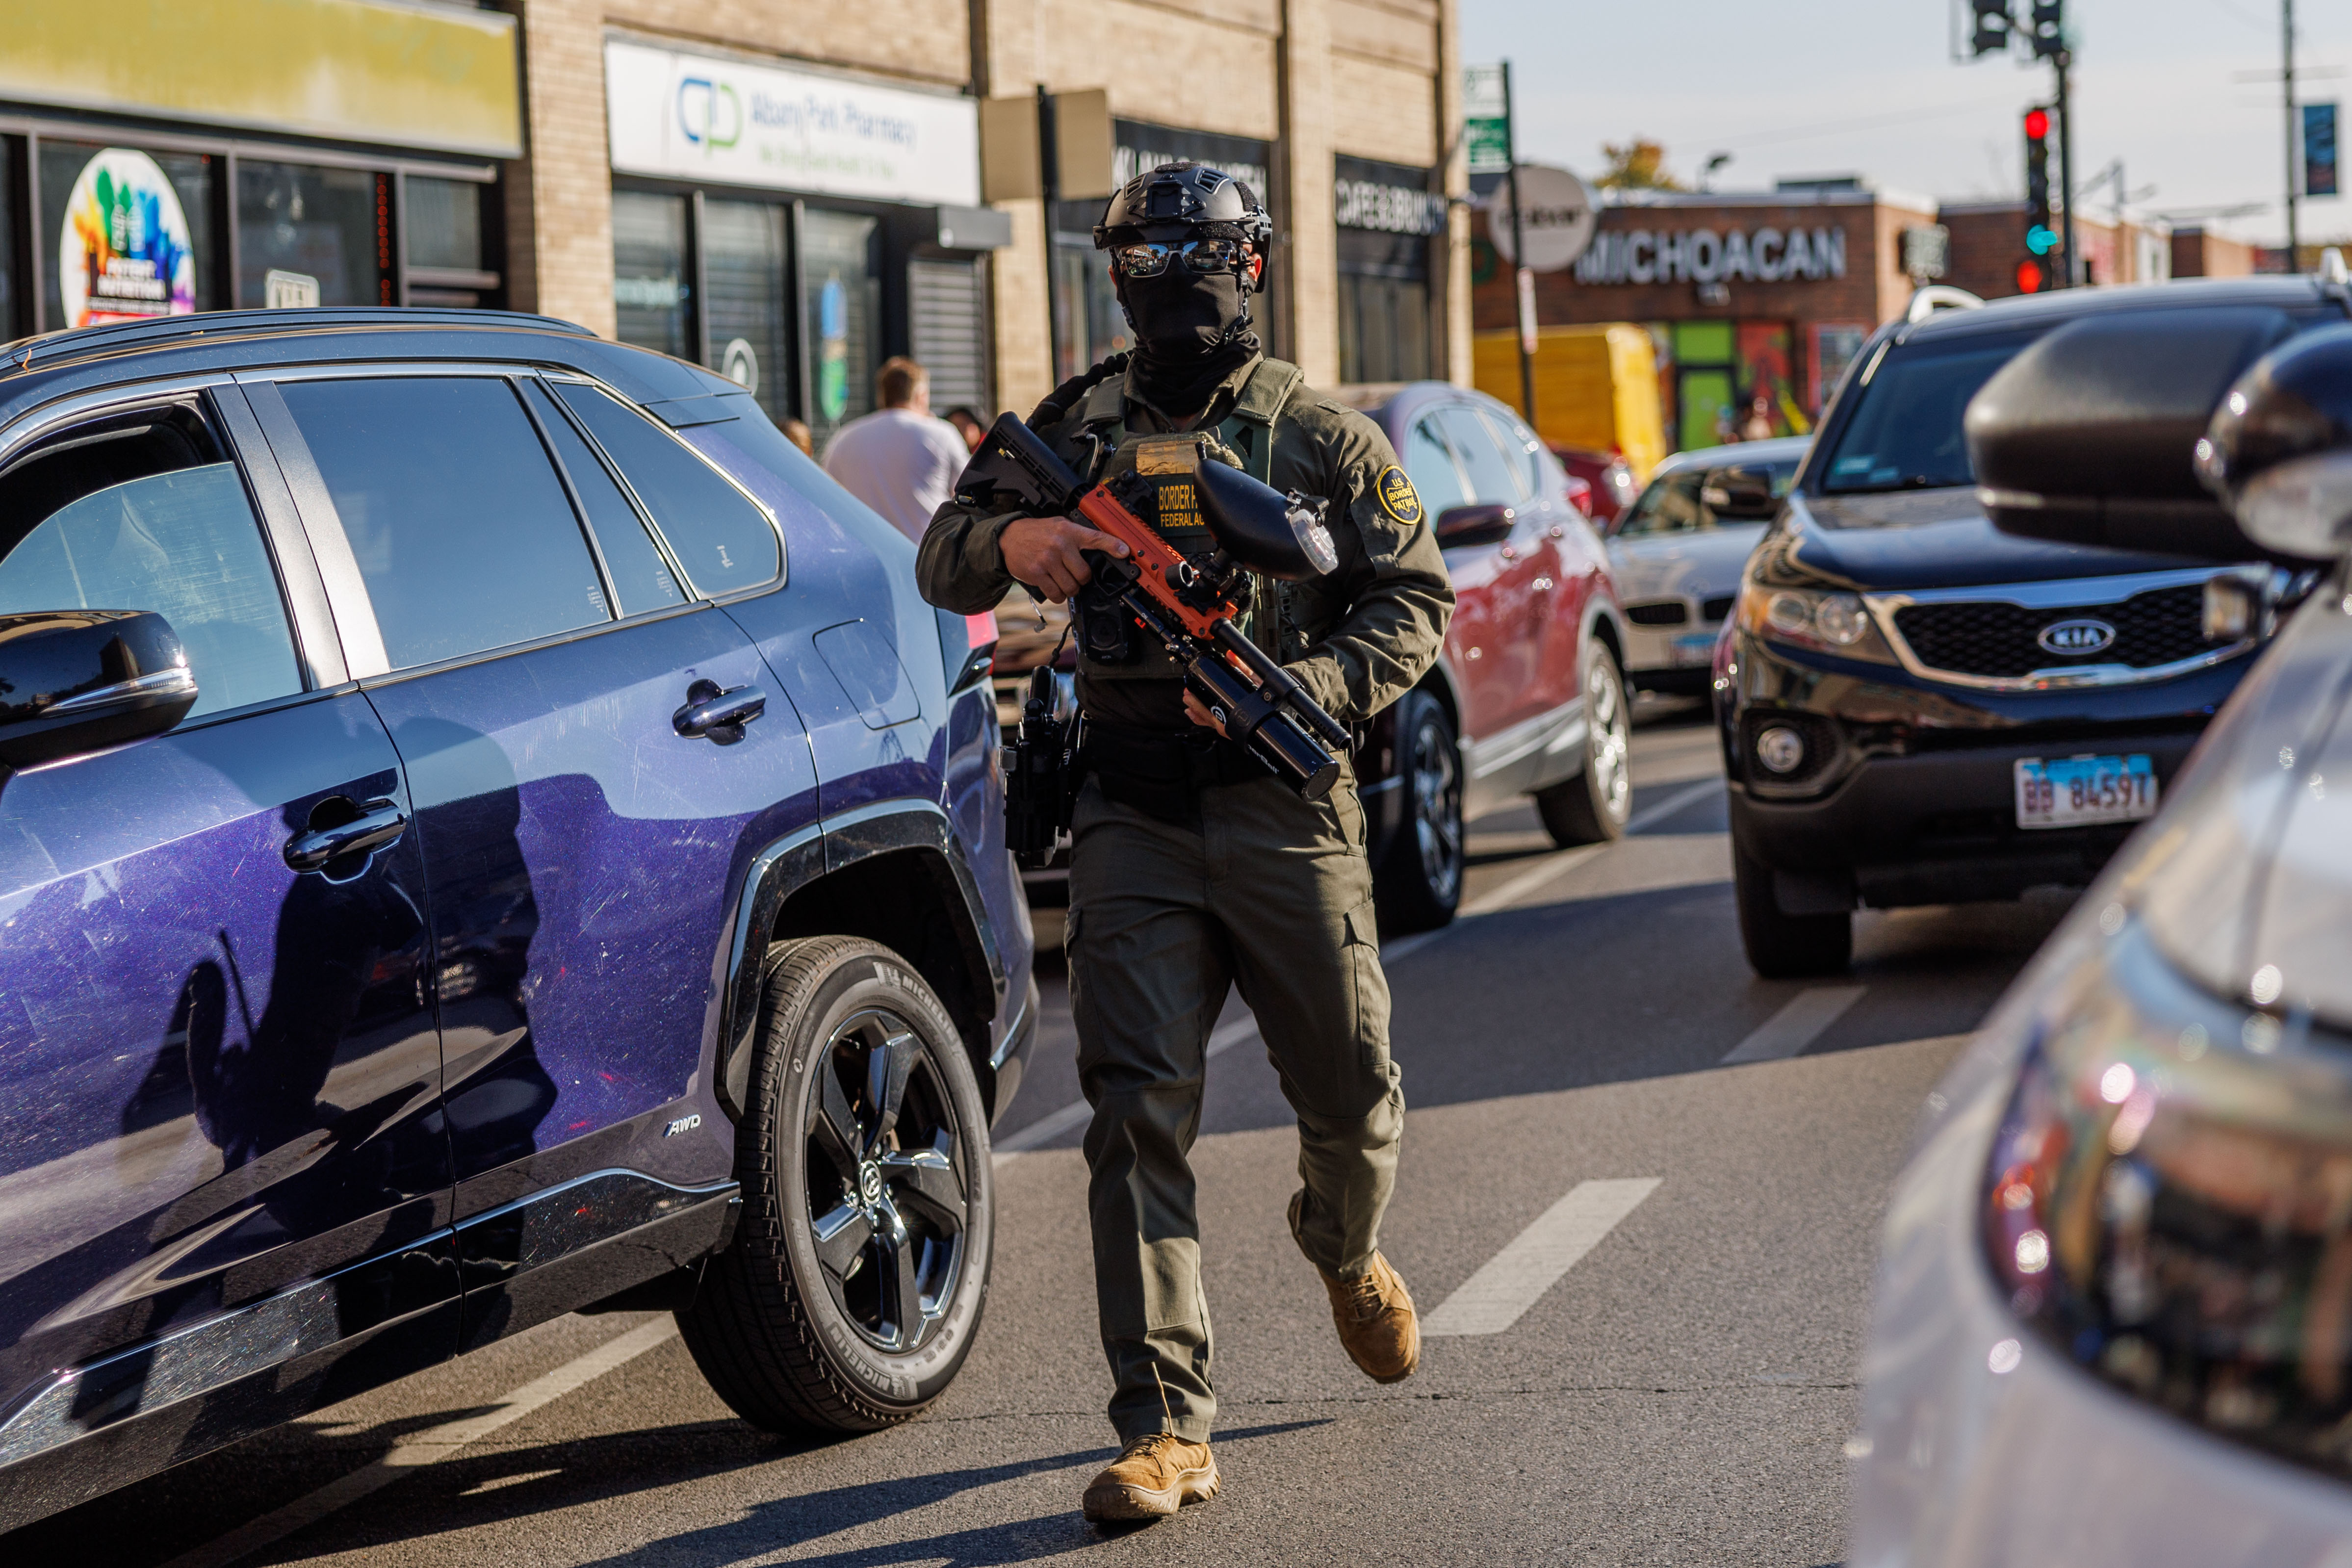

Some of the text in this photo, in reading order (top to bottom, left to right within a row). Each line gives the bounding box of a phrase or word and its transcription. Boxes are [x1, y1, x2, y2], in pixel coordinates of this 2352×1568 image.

[1574, 227, 1845, 285] MICHOACAN
[1159, 485, 1190, 511] BORDER
[1389, 487, 1414, 501] BORDER
[1393, 496, 1415, 511] PATROL
[1161, 513, 1193, 527] FEDERAL
[902, 975, 957, 1042] MICHELIN
[666, 1114, 701, 1137] AWD
[830, 1326, 891, 1392] MICHELIN
